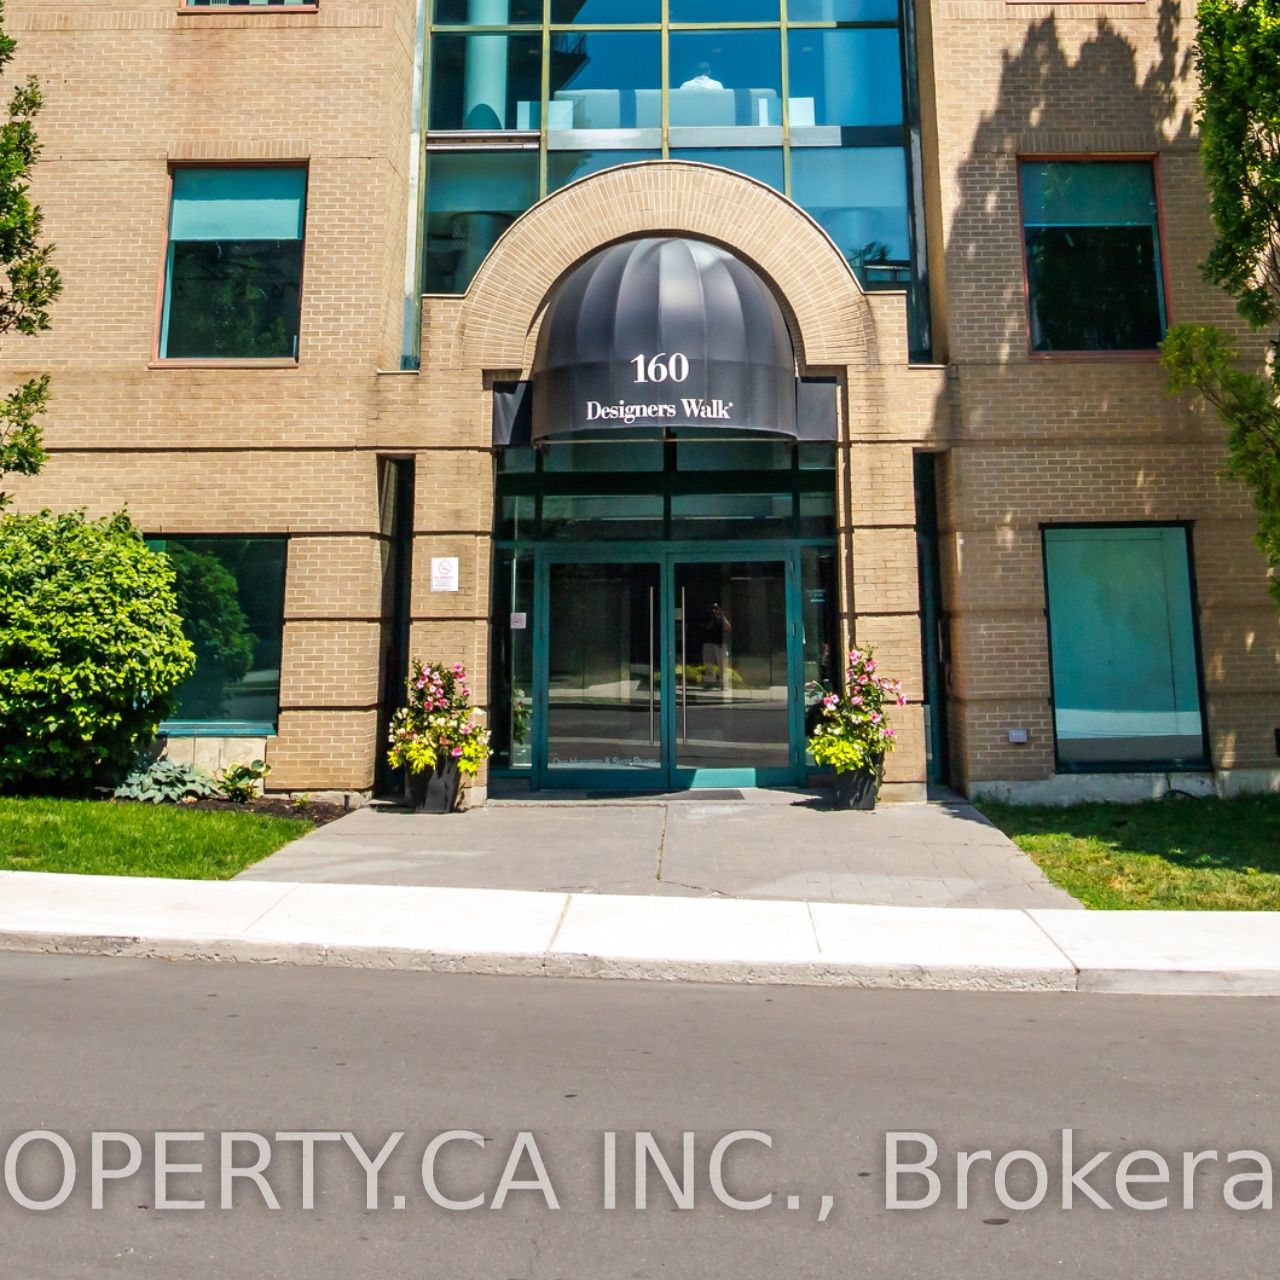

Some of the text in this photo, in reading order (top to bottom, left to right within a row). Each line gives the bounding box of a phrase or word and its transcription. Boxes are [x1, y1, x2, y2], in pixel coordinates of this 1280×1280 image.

[630, 352, 690, 383] 160
[586, 398, 731, 424] Designers Walk
